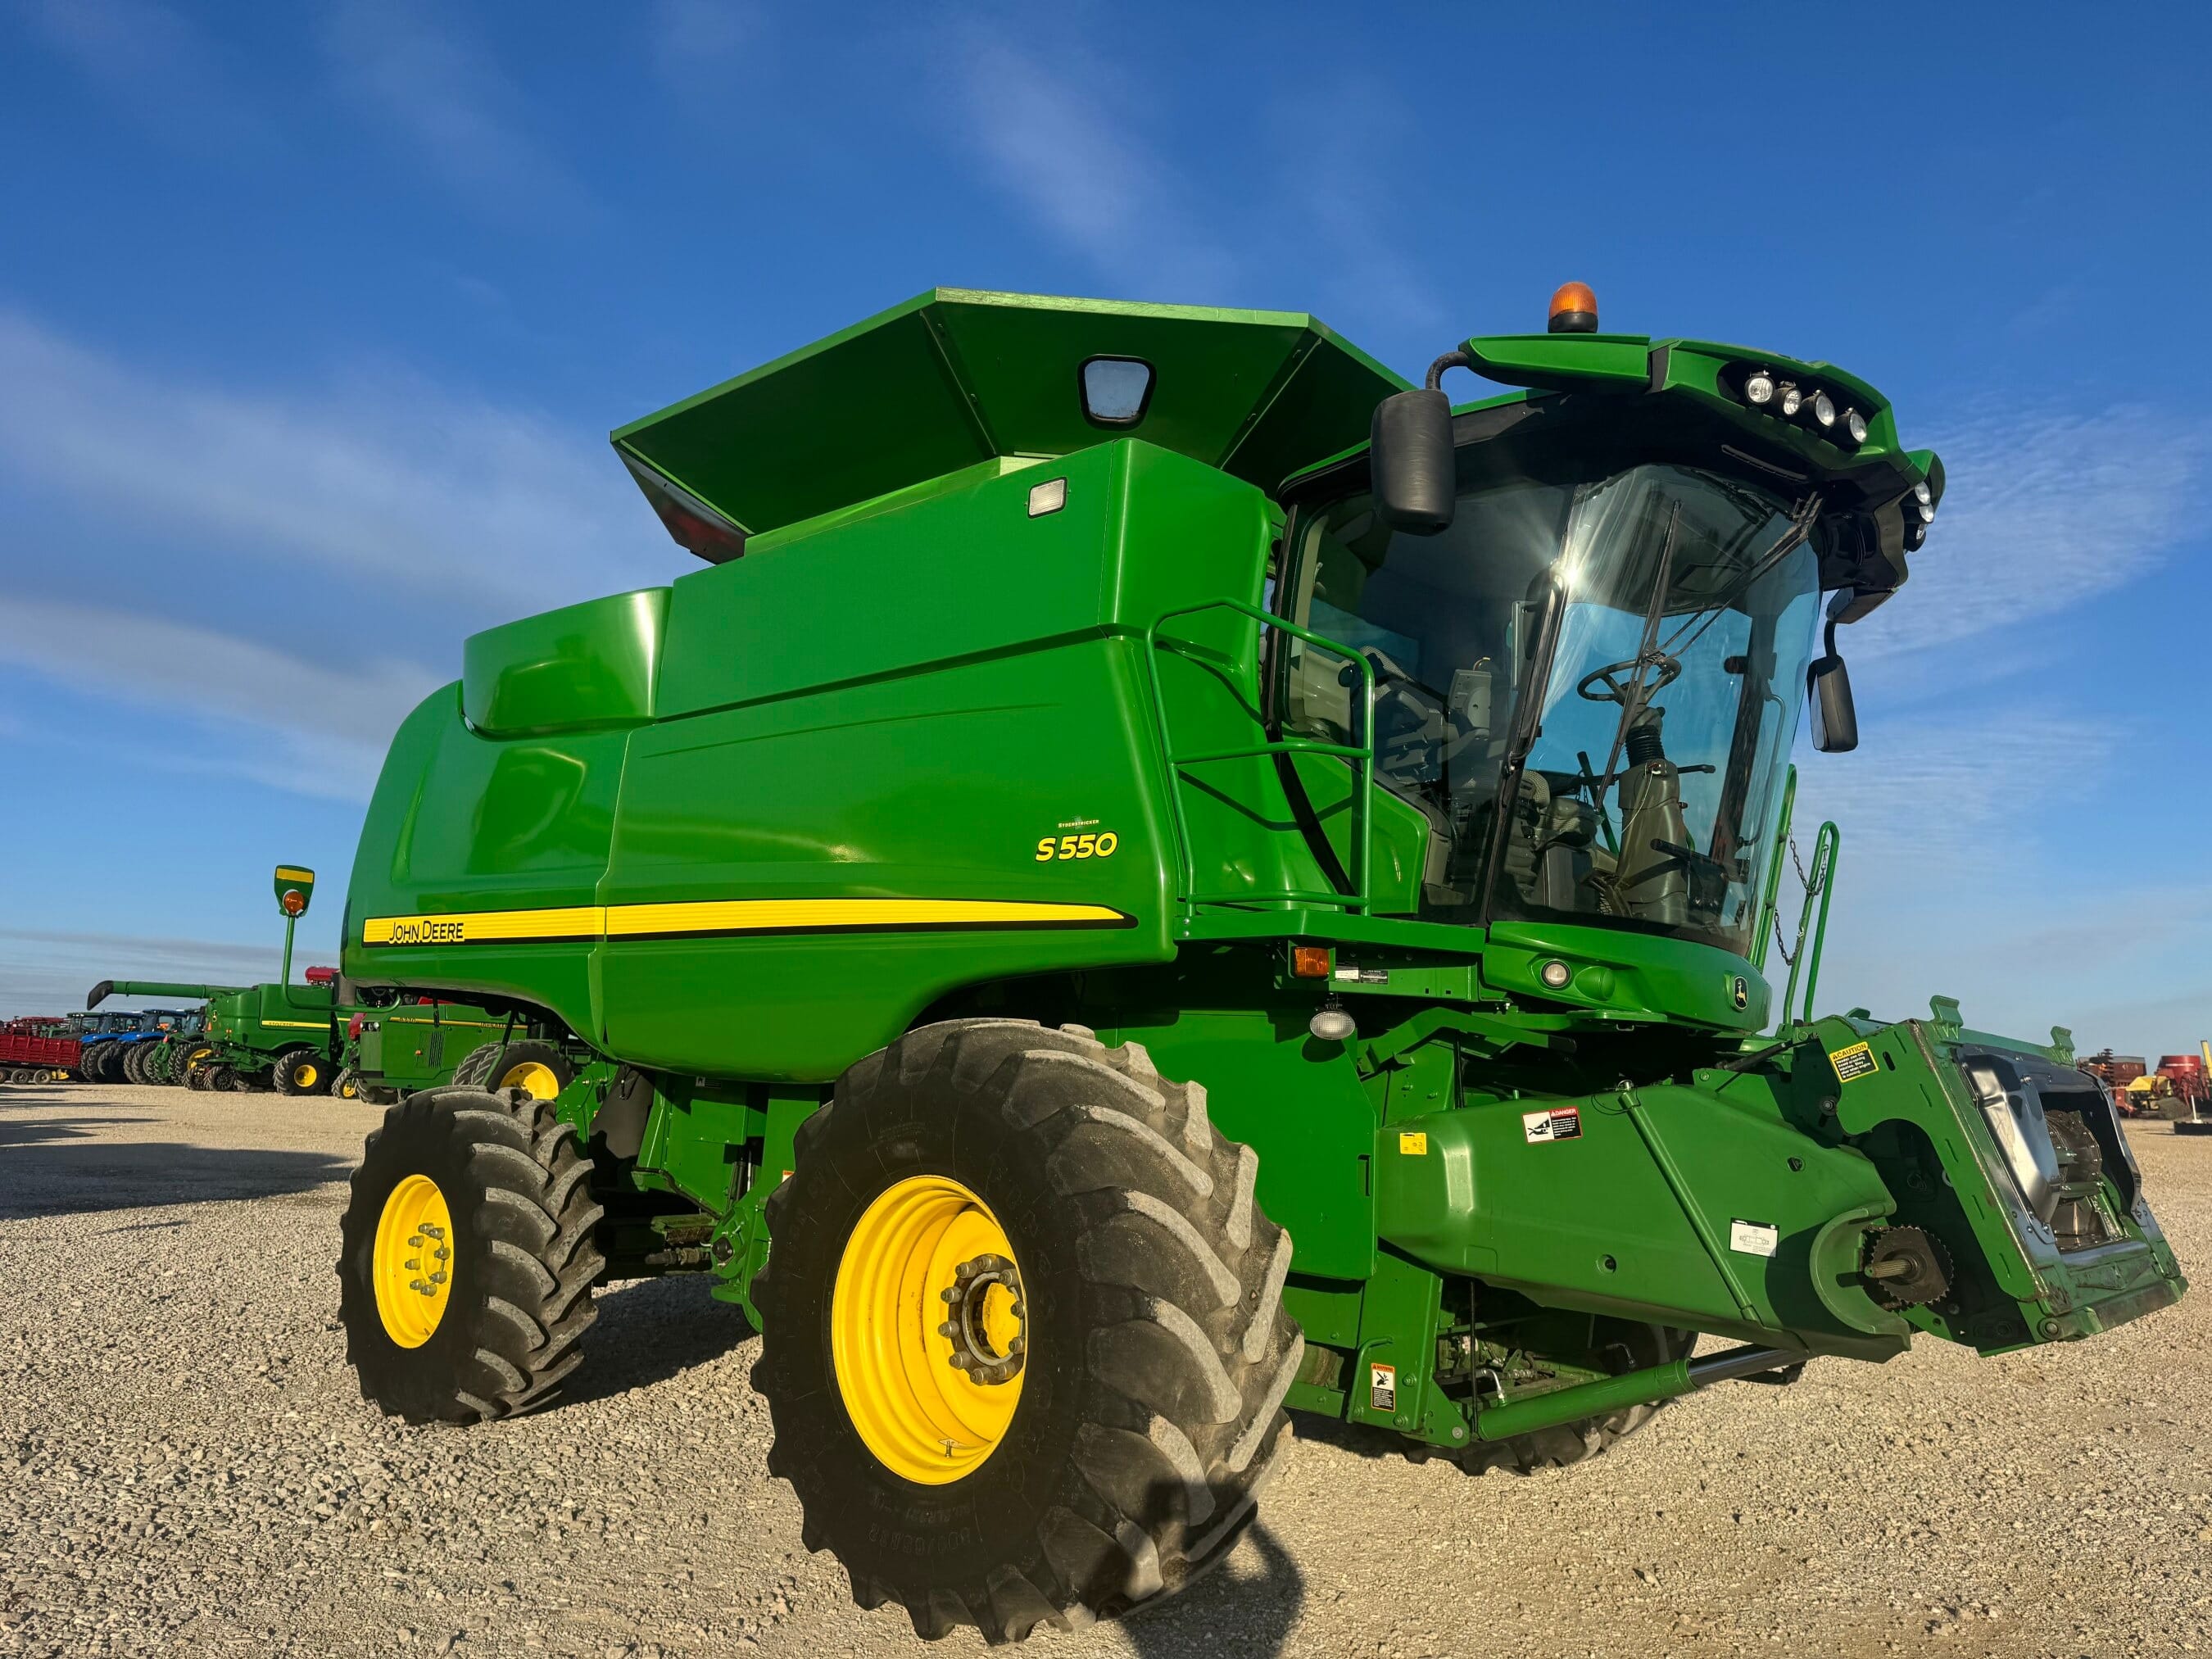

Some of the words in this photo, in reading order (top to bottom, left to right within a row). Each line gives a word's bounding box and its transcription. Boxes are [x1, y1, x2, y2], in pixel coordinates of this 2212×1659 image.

[389, 922, 420, 941] JOHN
[422, 920, 465, 940] DEERE
[1837, 1043, 1867, 1058] CAUTION
[1555, 1108, 1577, 1116] DANGER
